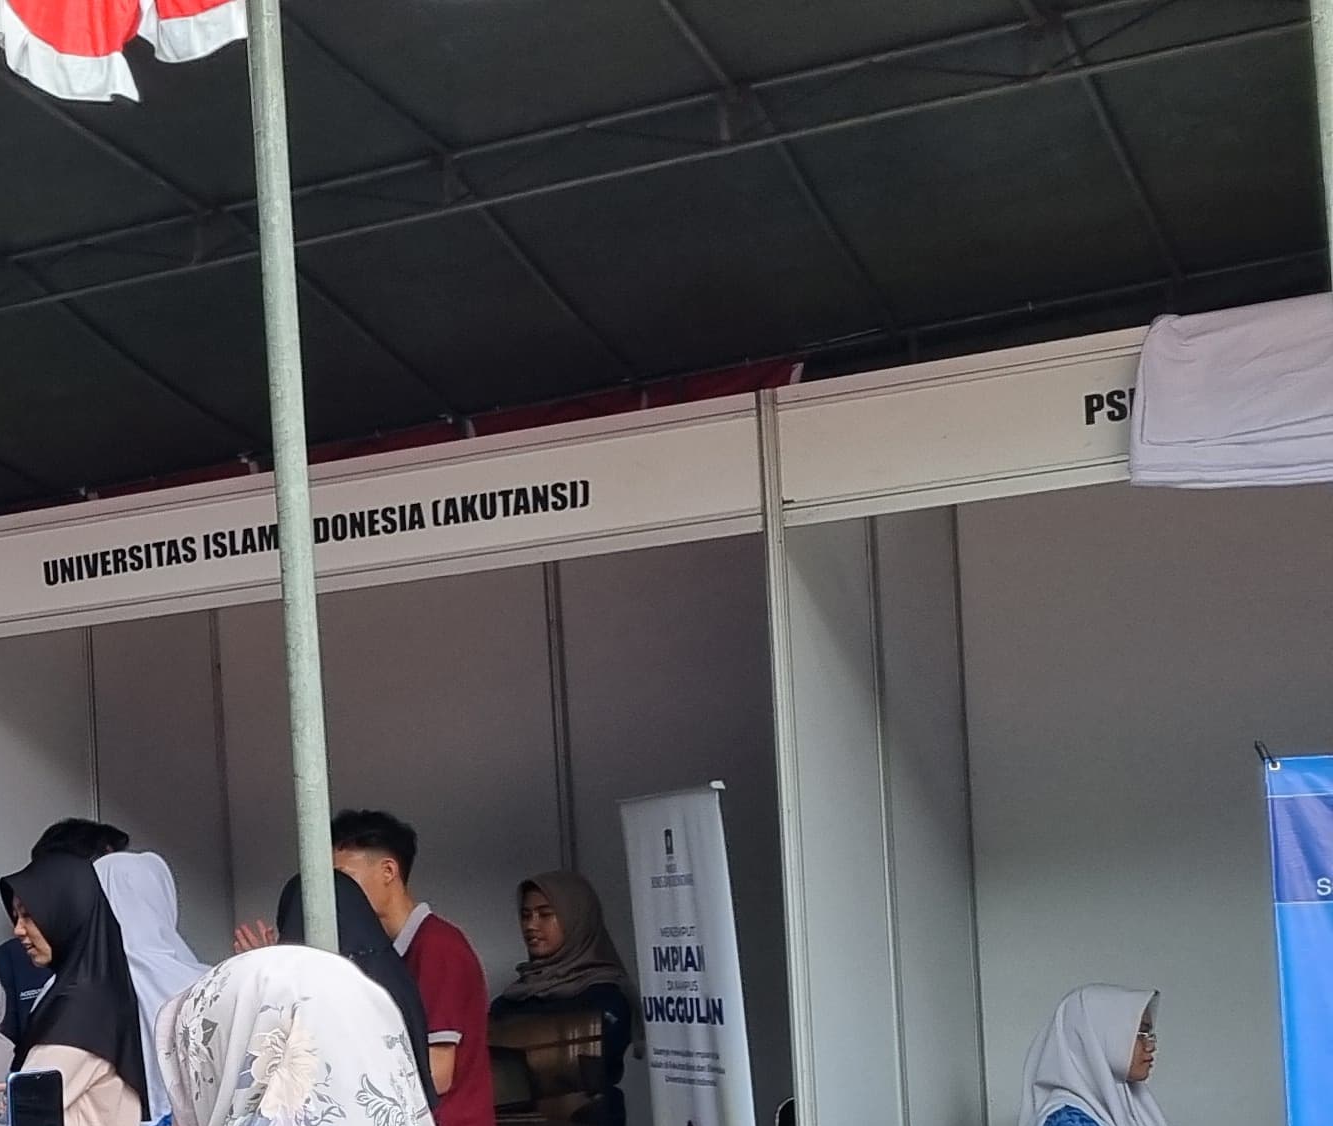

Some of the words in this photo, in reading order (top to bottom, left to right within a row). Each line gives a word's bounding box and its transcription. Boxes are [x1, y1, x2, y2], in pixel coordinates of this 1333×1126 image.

[43, 536, 196, 587] UNIVERSITAS
[203, 523, 279, 558] ISLAM
[313, 502, 426, 545] DONESIA
[431, 479, 590, 528] (AKUTANSI)
[653, 945, 706, 973] IMPIAN
[642, 995, 724, 1025] UNGGULAN
